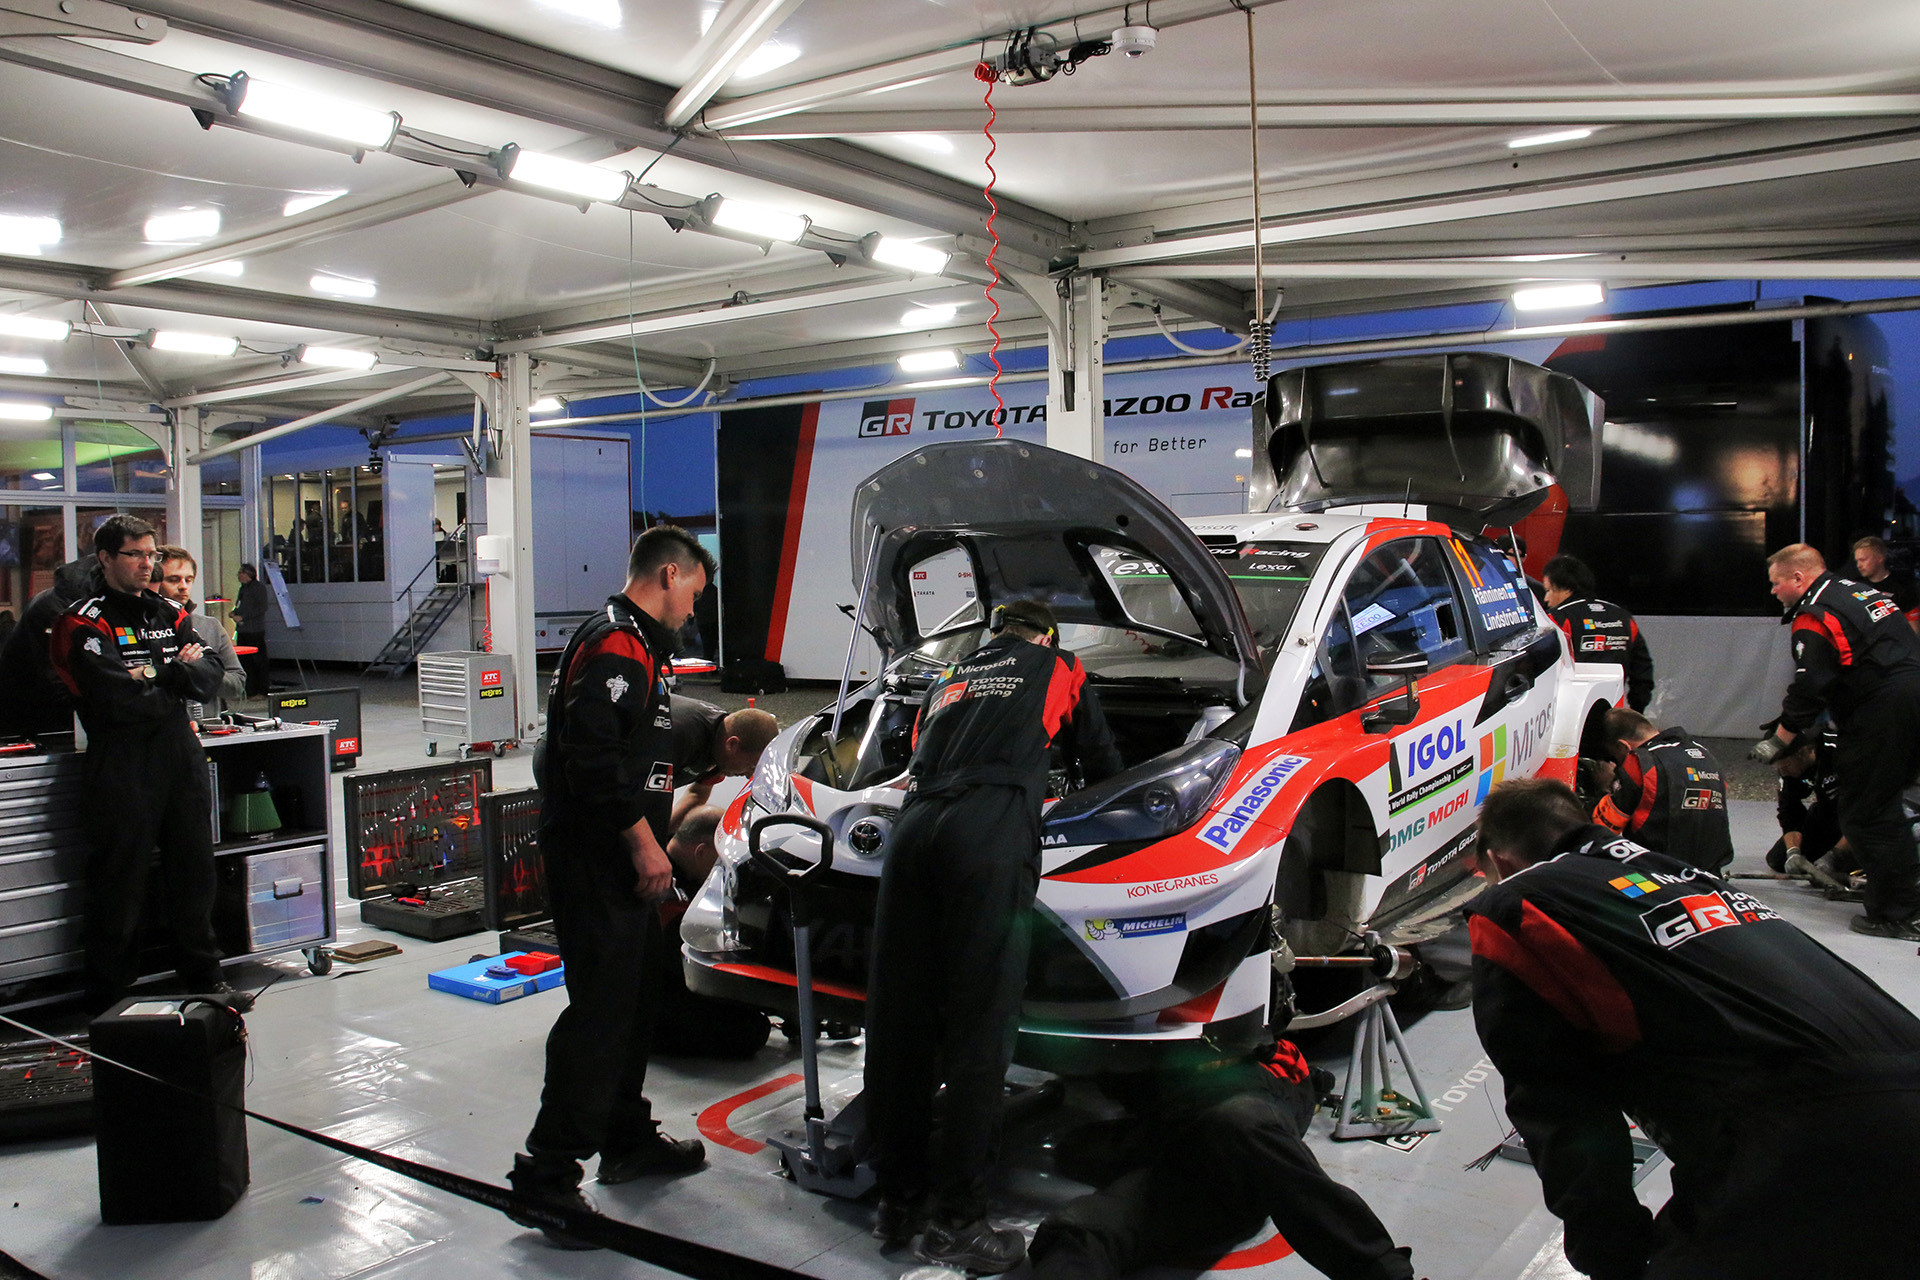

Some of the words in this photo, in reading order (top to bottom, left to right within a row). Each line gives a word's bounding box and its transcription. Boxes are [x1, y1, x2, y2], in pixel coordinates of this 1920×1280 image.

[861, 413, 911, 437] GR
[922, 404, 1047, 431] TOYOTA
[1113, 440, 1138, 454] for
[1148, 437, 1207, 452] Better
[1239, 548, 1311, 558] Racing
[1249, 562, 1296, 571] Lexar
[1471, 585, 1509, 605] Hänninen
[1482, 608, 1521, 632] Lindström
[957, 656, 1017, 675] Microsoft
[968, 683, 1017, 692] GAZOO
[971, 676, 1024, 685] TOYOTA
[964, 689, 1012, 698] Racing
[339, 740, 355, 748] KTC
[1408, 719, 1466, 778] IGOL
[1391, 796, 1406, 810] World
[1406, 790, 1419, 802] Rally
[1419, 773, 1452, 796] Championship
[1204, 757, 1302, 848] Panasonic
[1428, 788, 1469, 829] MORI
[1684, 796, 1709, 809] GR
[1427, 846, 1458, 876] TOYOTA
[1127, 873, 1219, 899] KONECRANES
[1122, 915, 1185, 931] MICHELIN
[1655, 905, 1735, 947] GR
[1430, 1055, 1496, 1112] TOYOT
